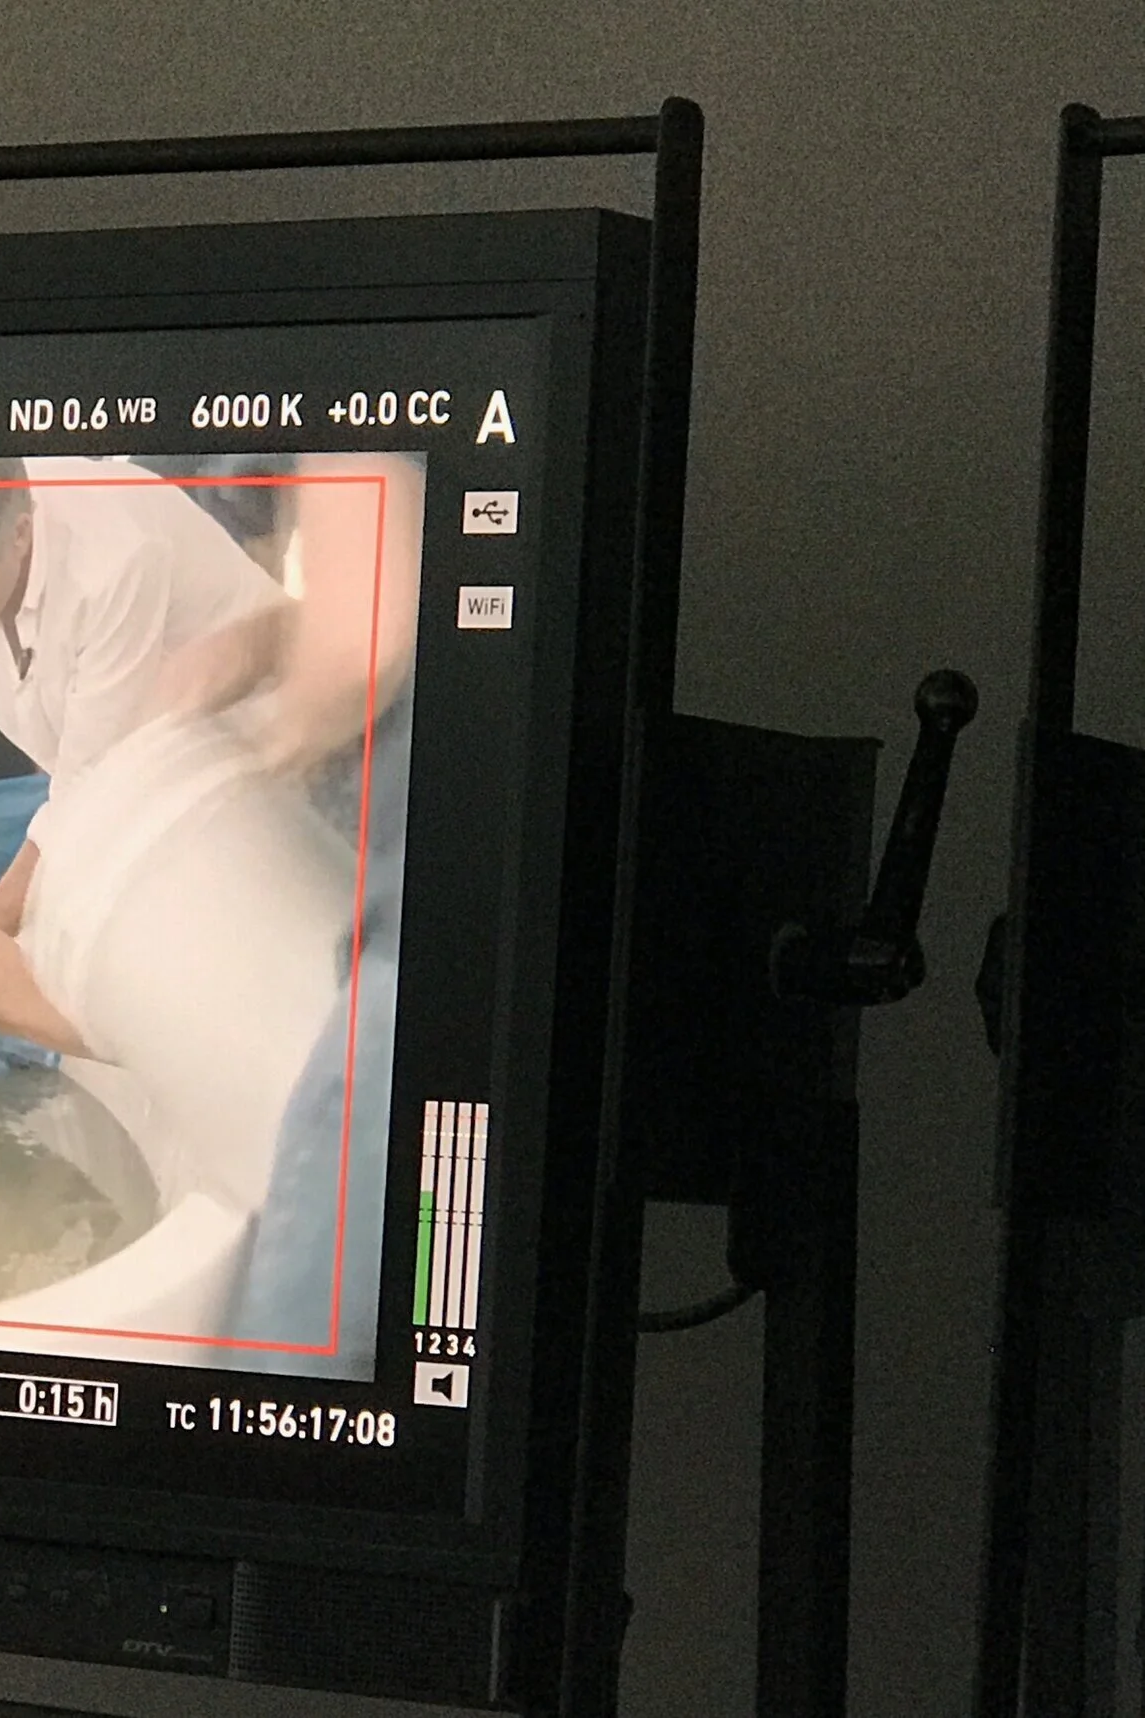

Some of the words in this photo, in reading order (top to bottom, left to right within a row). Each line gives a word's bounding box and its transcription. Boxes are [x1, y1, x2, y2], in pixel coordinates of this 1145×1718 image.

[9, 400, 54, 431] ND
[62, 397, 108, 431] 0.6
[117, 398, 156, 423] WB
[191, 394, 270, 428] 6000
[280, 393, 304, 427] K
[328, 391, 398, 426] +0.0
[407, 390, 452, 425] CC
[475, 389, 517, 445] A
[468, 598, 505, 616] WiFi
[165, 1401, 197, 1430] TC
[209, 1398, 397, 1448] 11:56:17:08
